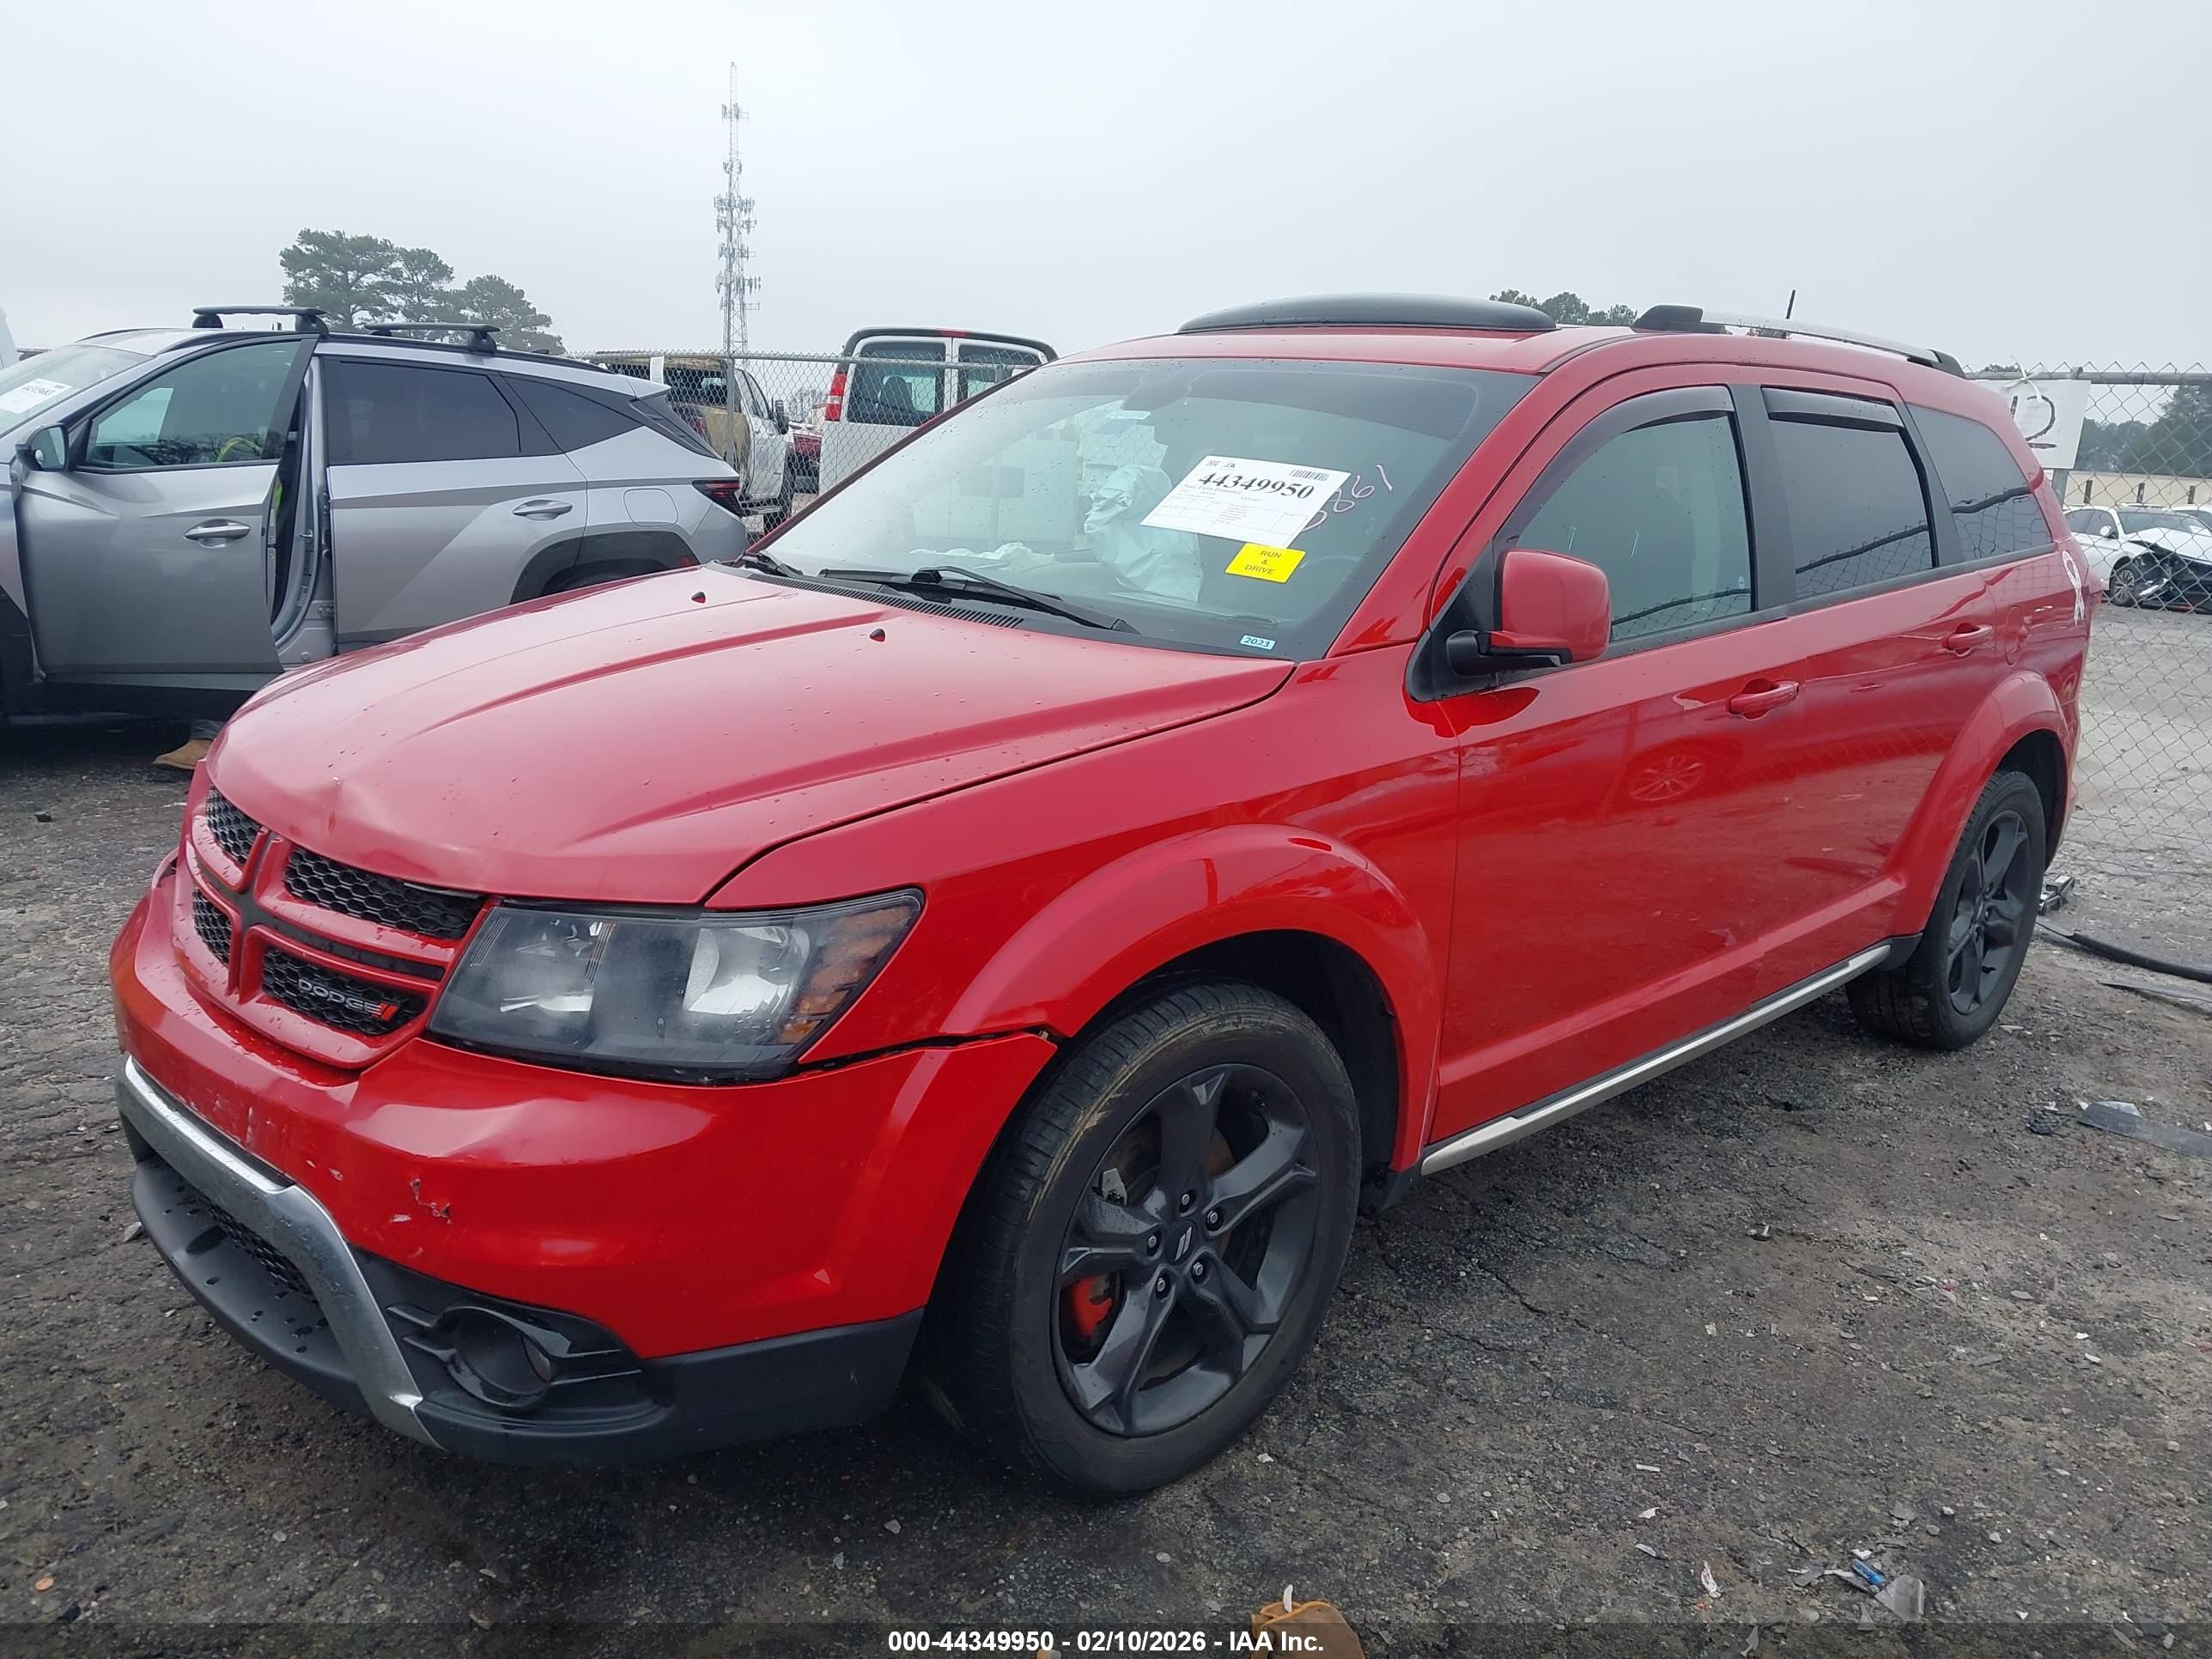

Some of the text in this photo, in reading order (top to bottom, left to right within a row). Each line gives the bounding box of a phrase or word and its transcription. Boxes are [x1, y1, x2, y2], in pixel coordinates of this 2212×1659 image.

[1198, 472, 1315, 499] 44349950
[1244, 564, 1276, 574] DRIVE
[1243, 636, 1271, 647] 2023
[298, 978, 382, 1016] DODGE
